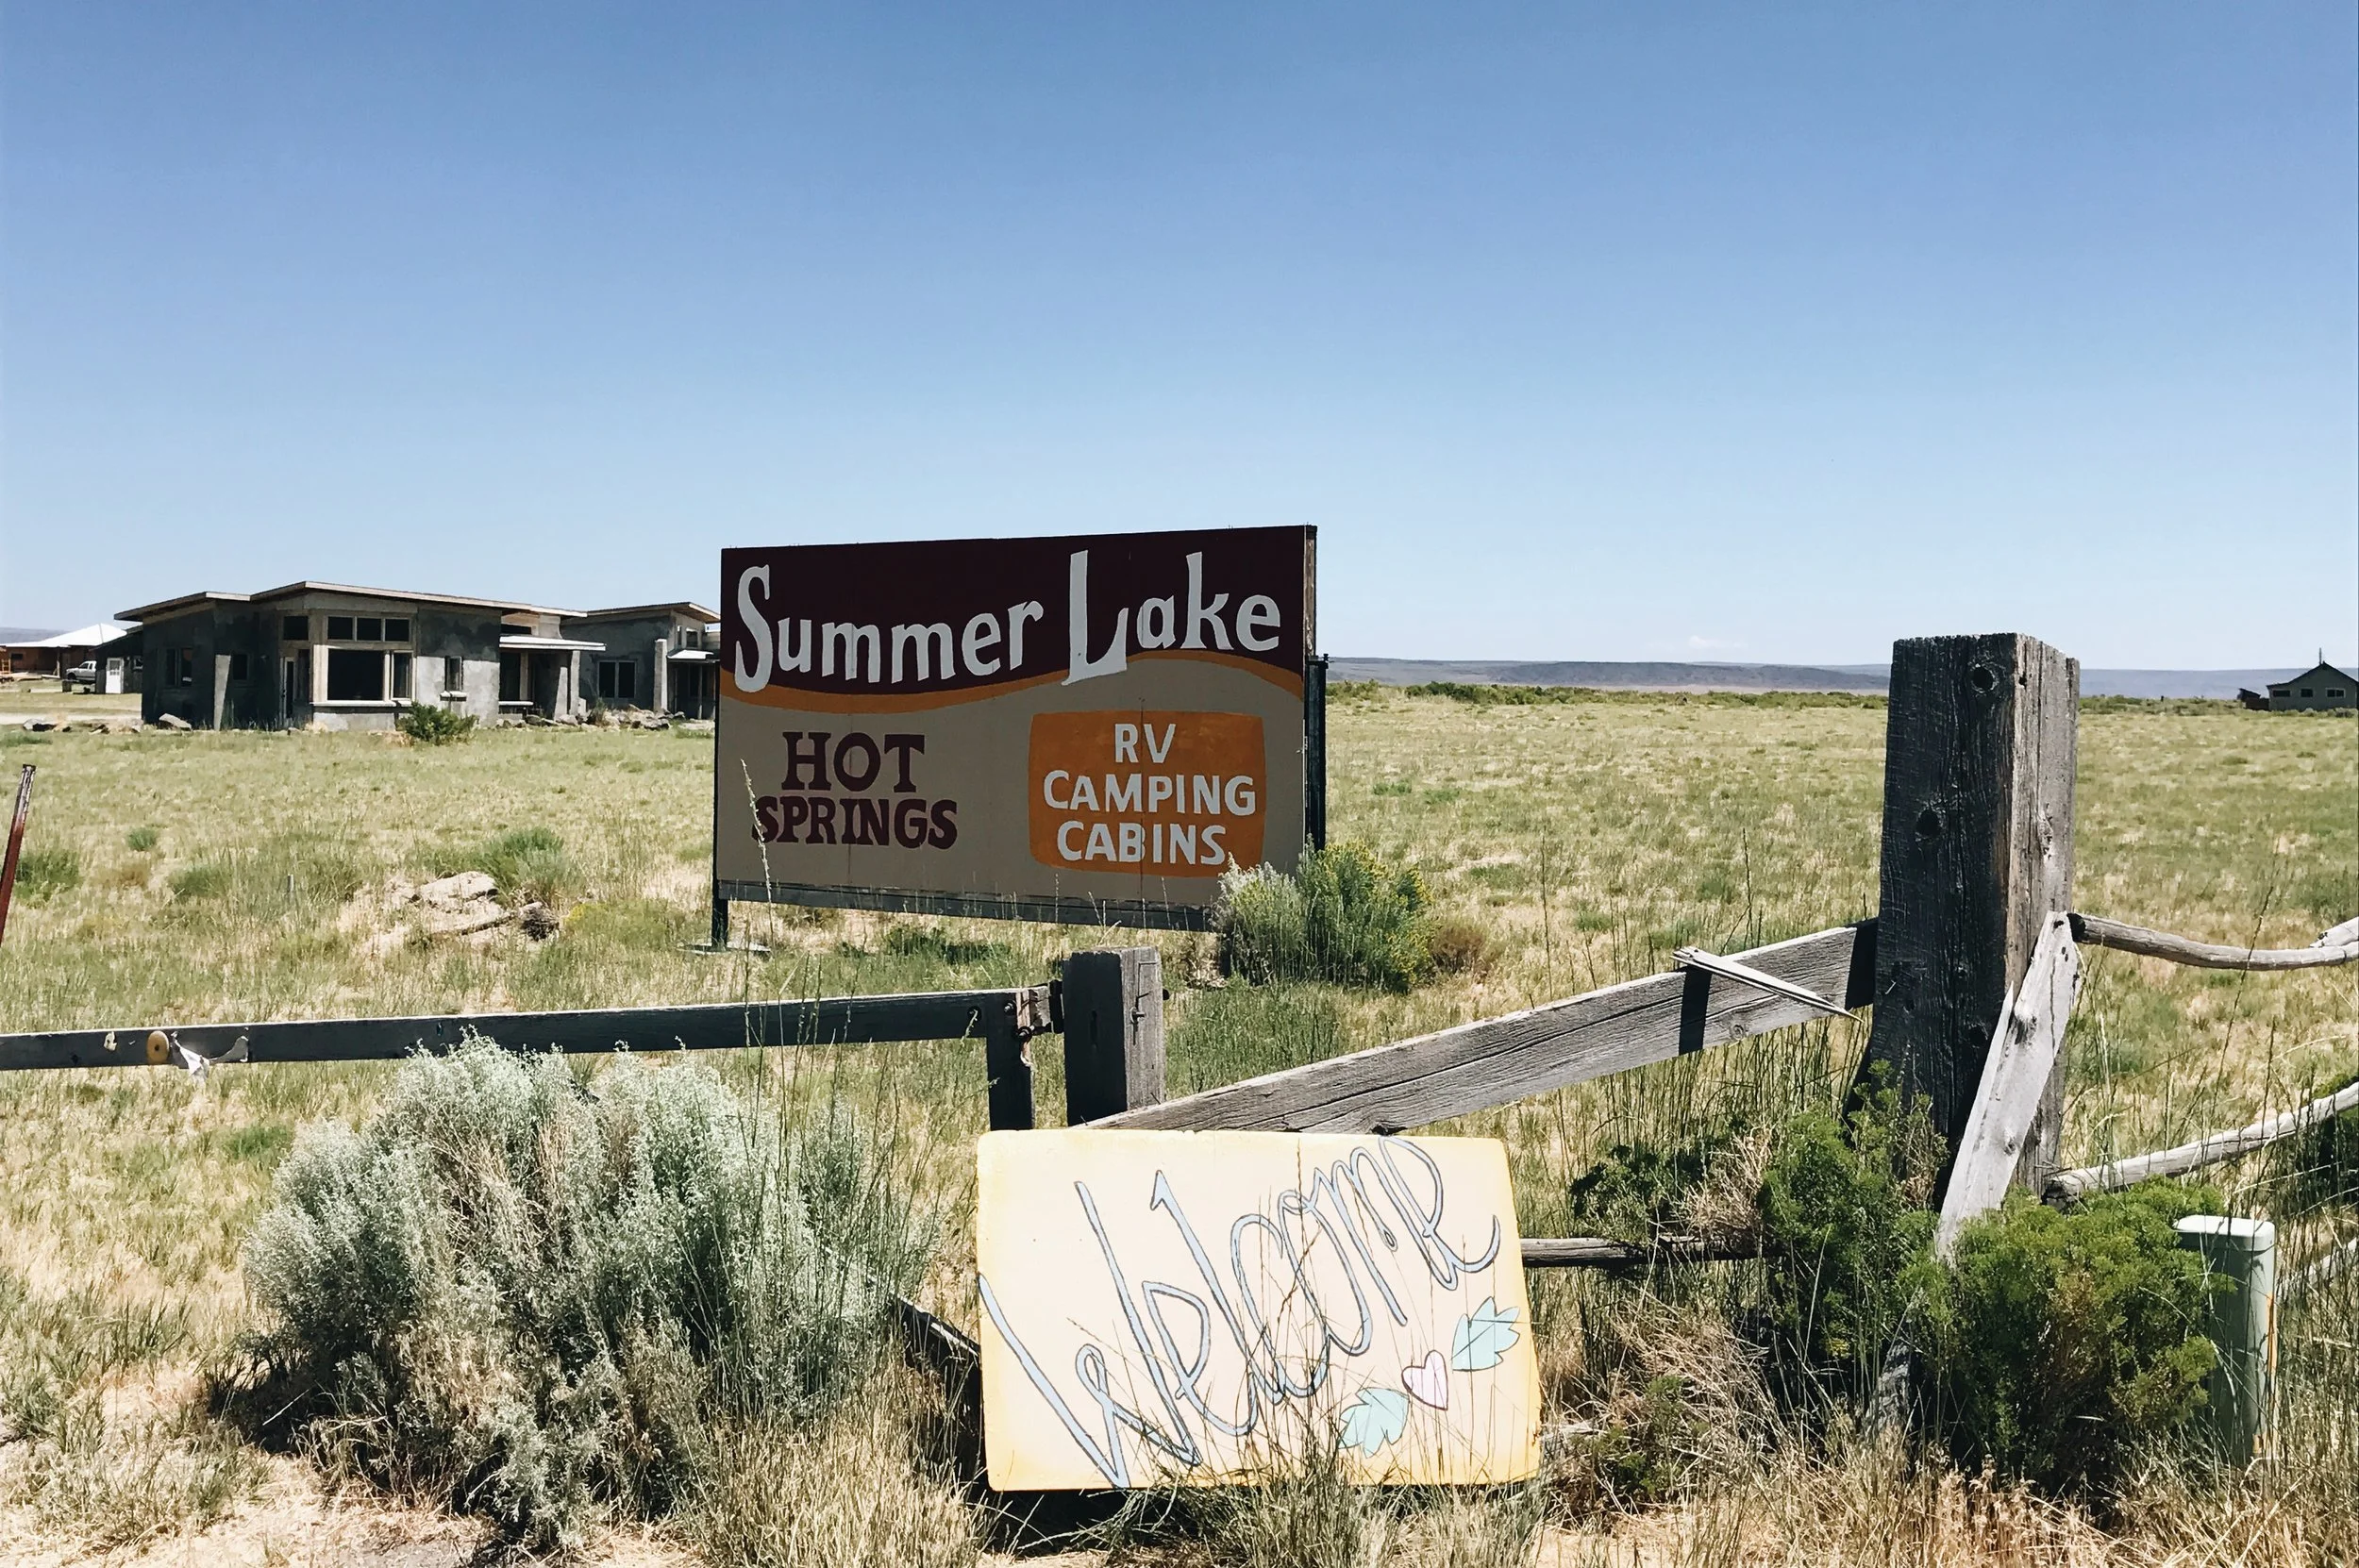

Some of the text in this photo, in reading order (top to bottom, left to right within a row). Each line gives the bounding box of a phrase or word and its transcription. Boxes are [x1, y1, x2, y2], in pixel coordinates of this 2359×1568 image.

[734, 549, 1281, 692] Summer Lake
[781, 731, 926, 792] HOT
[1114, 724, 1177, 763] RV
[1043, 769, 1257, 816] CAMPING
[751, 796, 959, 850] SPRINGS
[1057, 820, 1227, 865] CABINS
